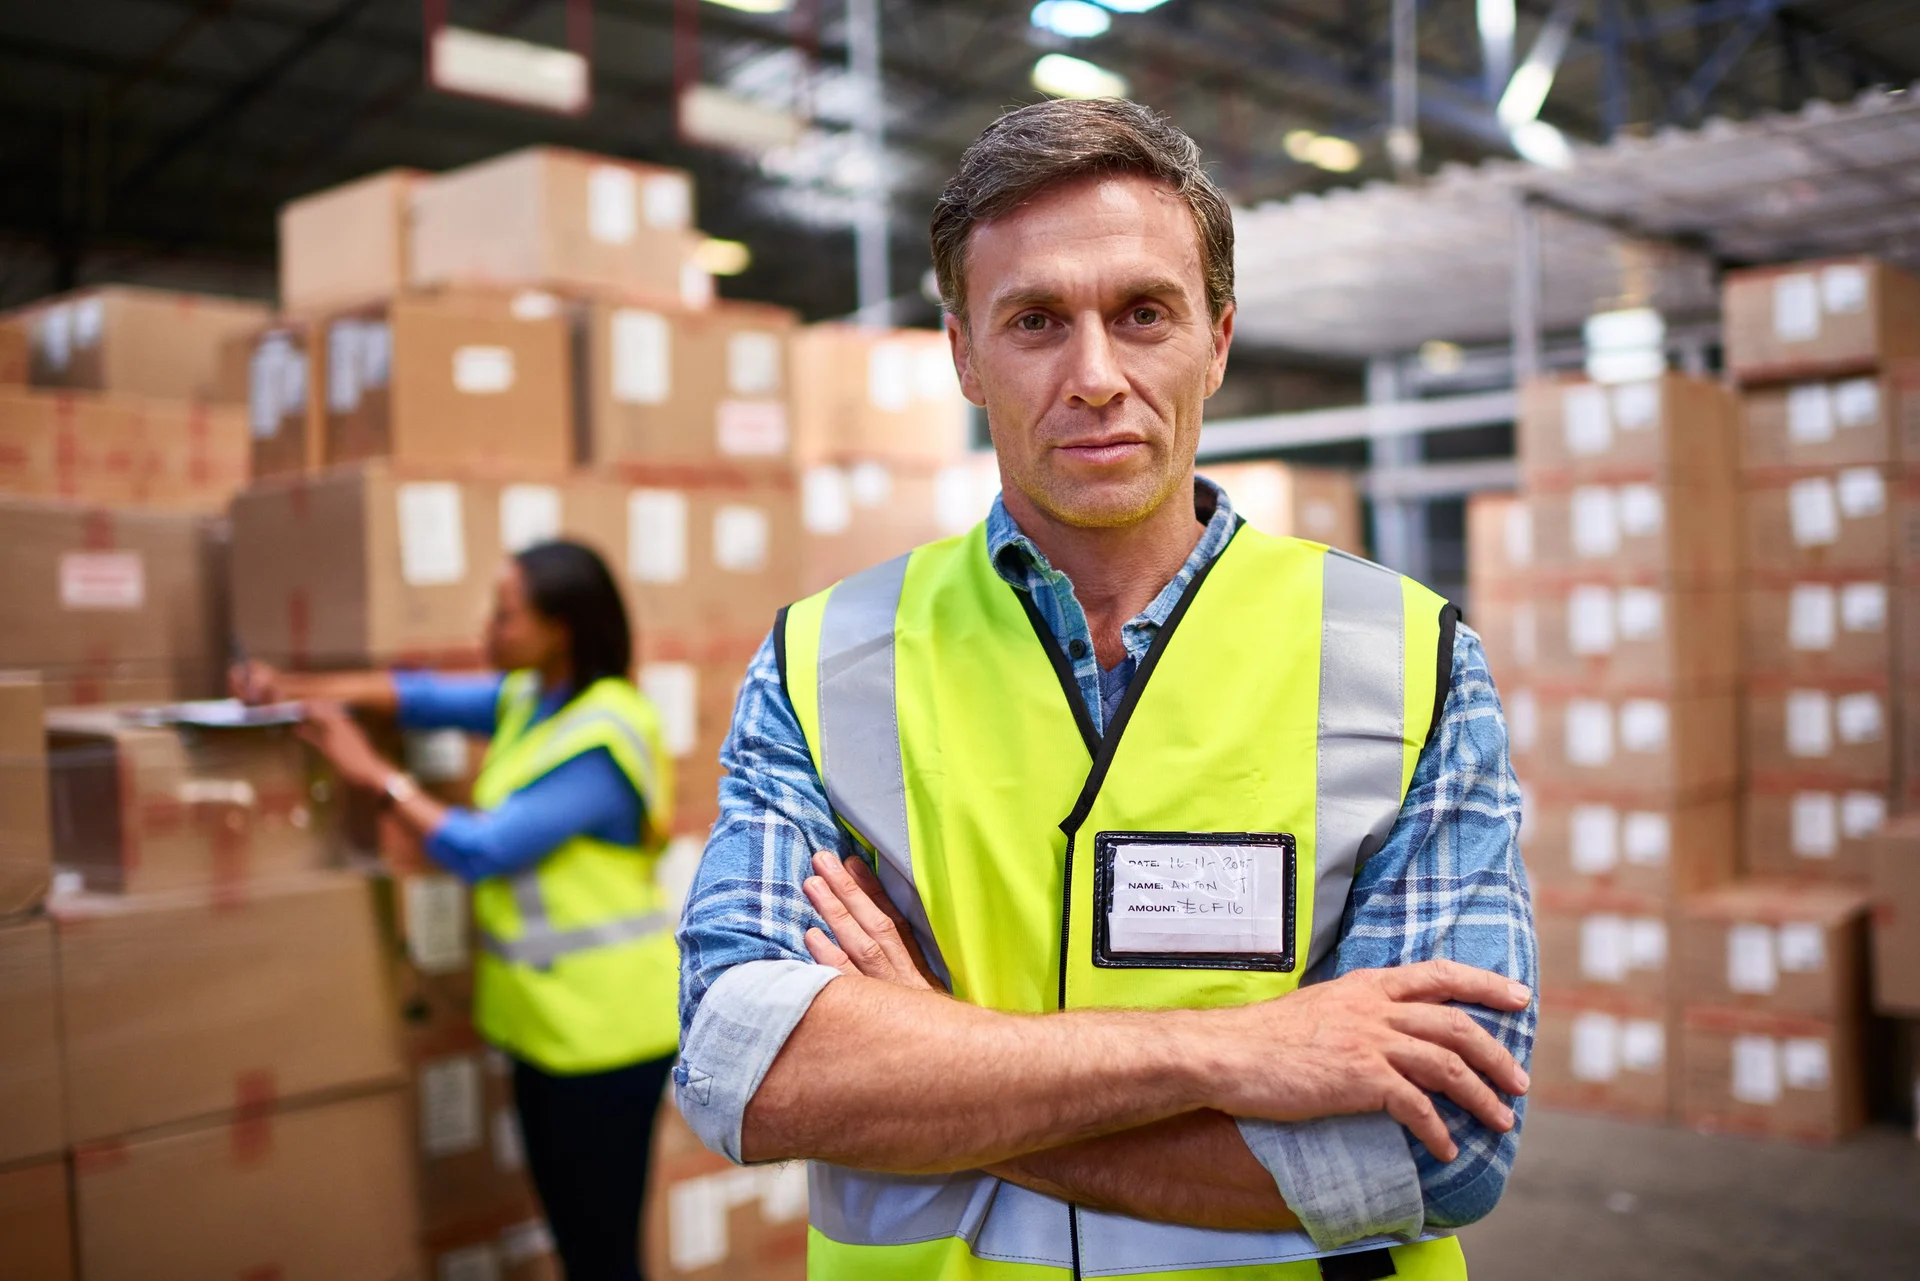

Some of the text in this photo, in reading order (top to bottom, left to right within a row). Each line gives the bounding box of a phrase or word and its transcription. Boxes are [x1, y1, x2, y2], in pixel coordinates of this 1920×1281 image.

[1128, 882, 1164, 890] NAME:
[1171, 880, 1218, 891] ANTON
[1128, 905, 1180, 913] AMOUNT:
